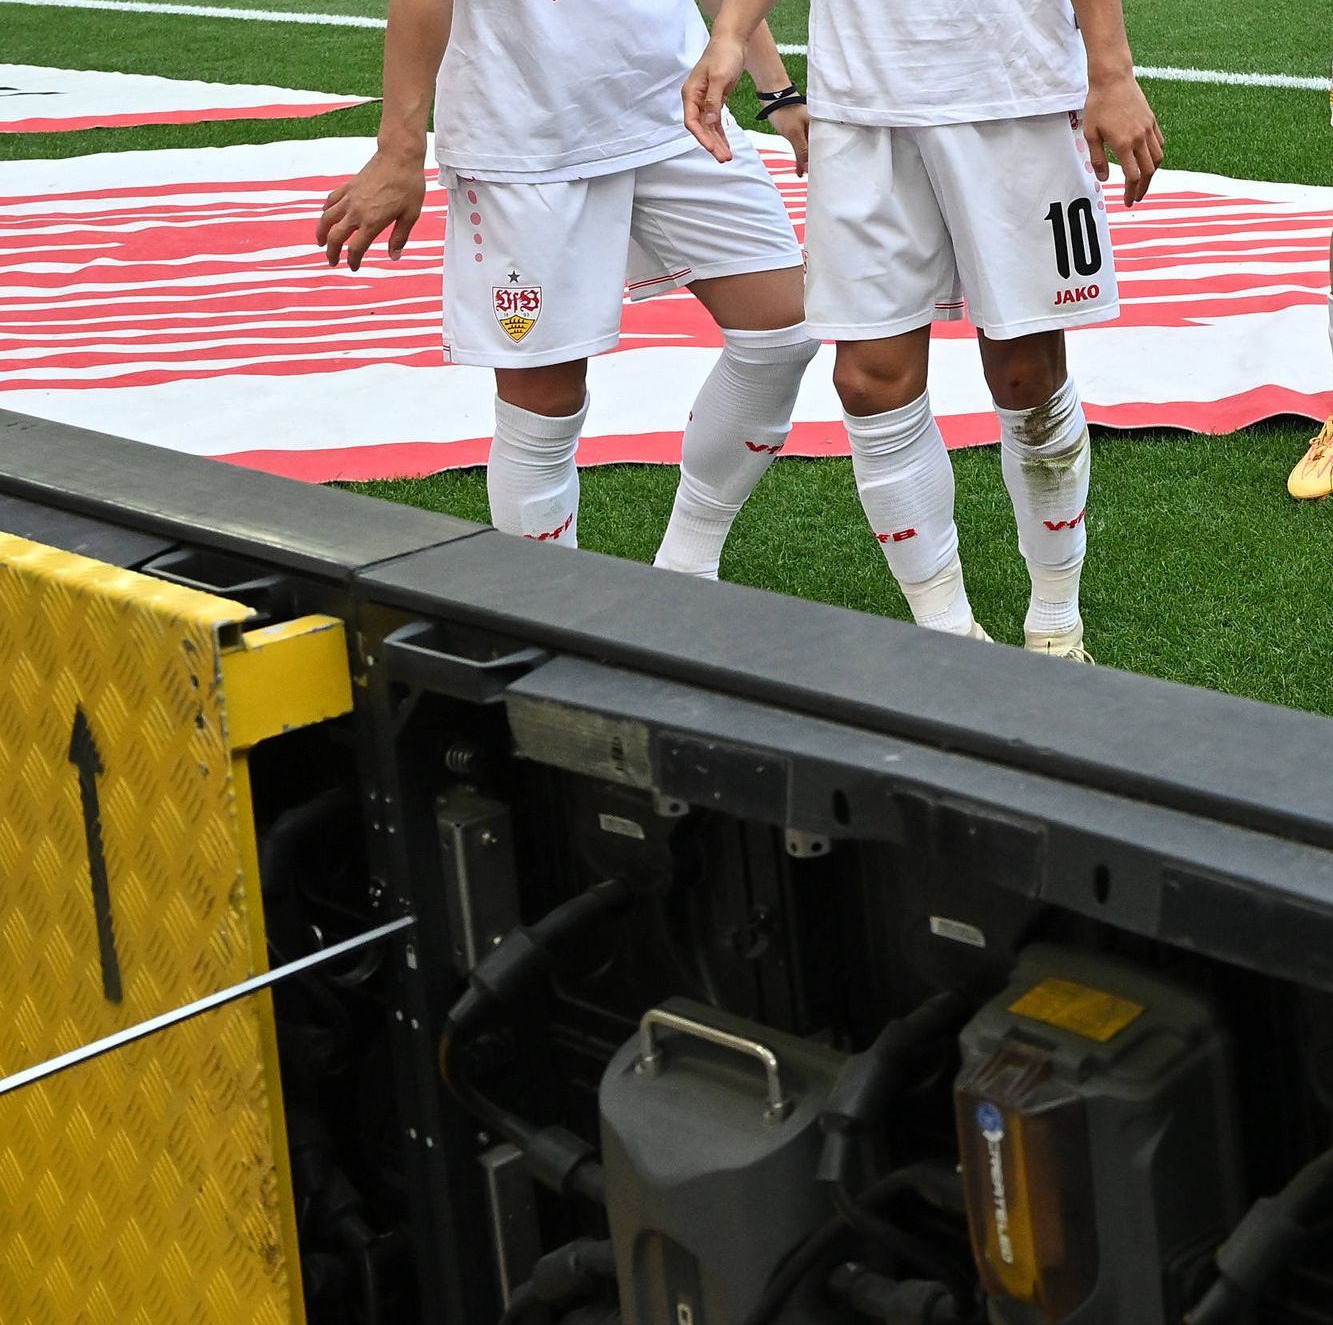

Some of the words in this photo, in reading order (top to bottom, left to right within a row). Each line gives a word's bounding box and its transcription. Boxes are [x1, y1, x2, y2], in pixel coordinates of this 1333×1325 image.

[1044, 198, 1101, 279] 10
[1054, 284, 1099, 304] JAKO
[745, 441, 785, 455] Vf
[1043, 509, 1086, 530] Vf
[874, 529, 917, 543] fB
